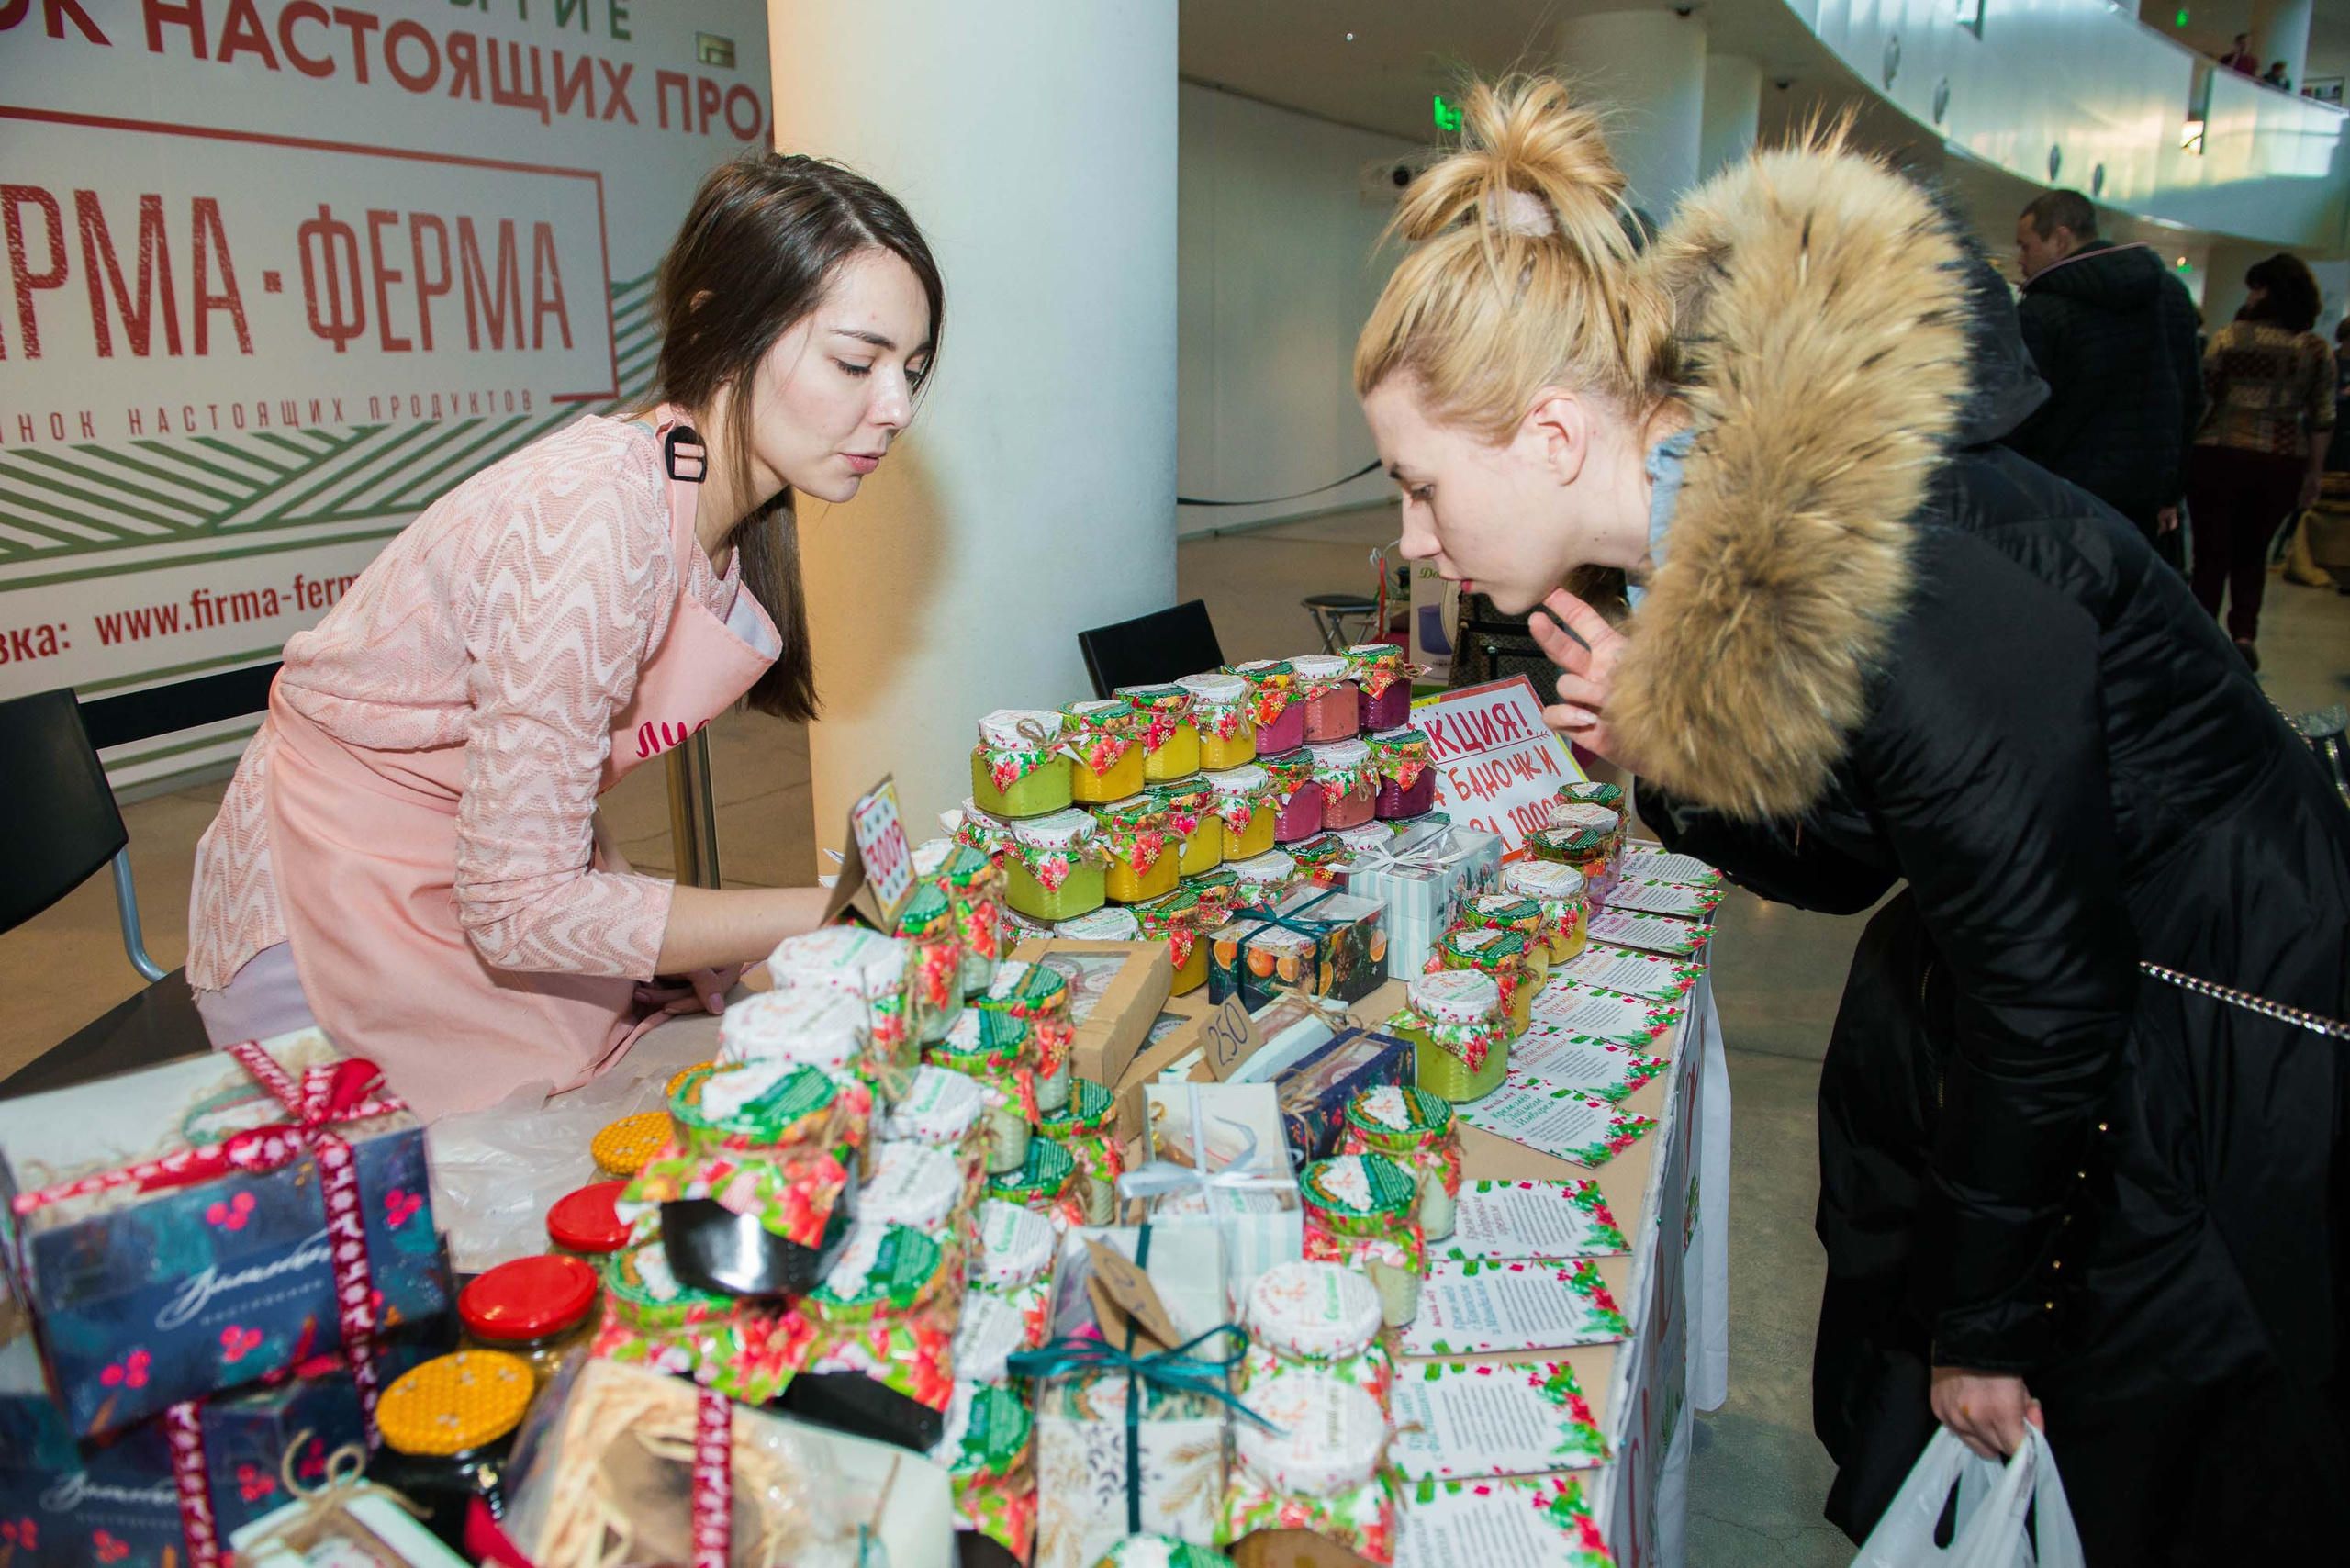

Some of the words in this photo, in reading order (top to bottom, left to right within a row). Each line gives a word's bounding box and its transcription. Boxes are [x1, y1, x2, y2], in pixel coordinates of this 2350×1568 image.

[449, 0, 633, 41] ИЕ
[142, 0, 640, 127] НАСТОЯЩИХ
[655, 68, 774, 154] ПРО
[0, 183, 255, 361] РМА
[297, 202, 575, 353] ФЕРМА
[0, 409, 95, 444] НОК
[127, 398, 345, 436] НАСТОЯЩИХ
[368, 388, 532, 421] ПРОДУКТОВ
[1423, 700, 1534, 762] КЦИЯ!
[1207, 1002, 1248, 1067] 250
